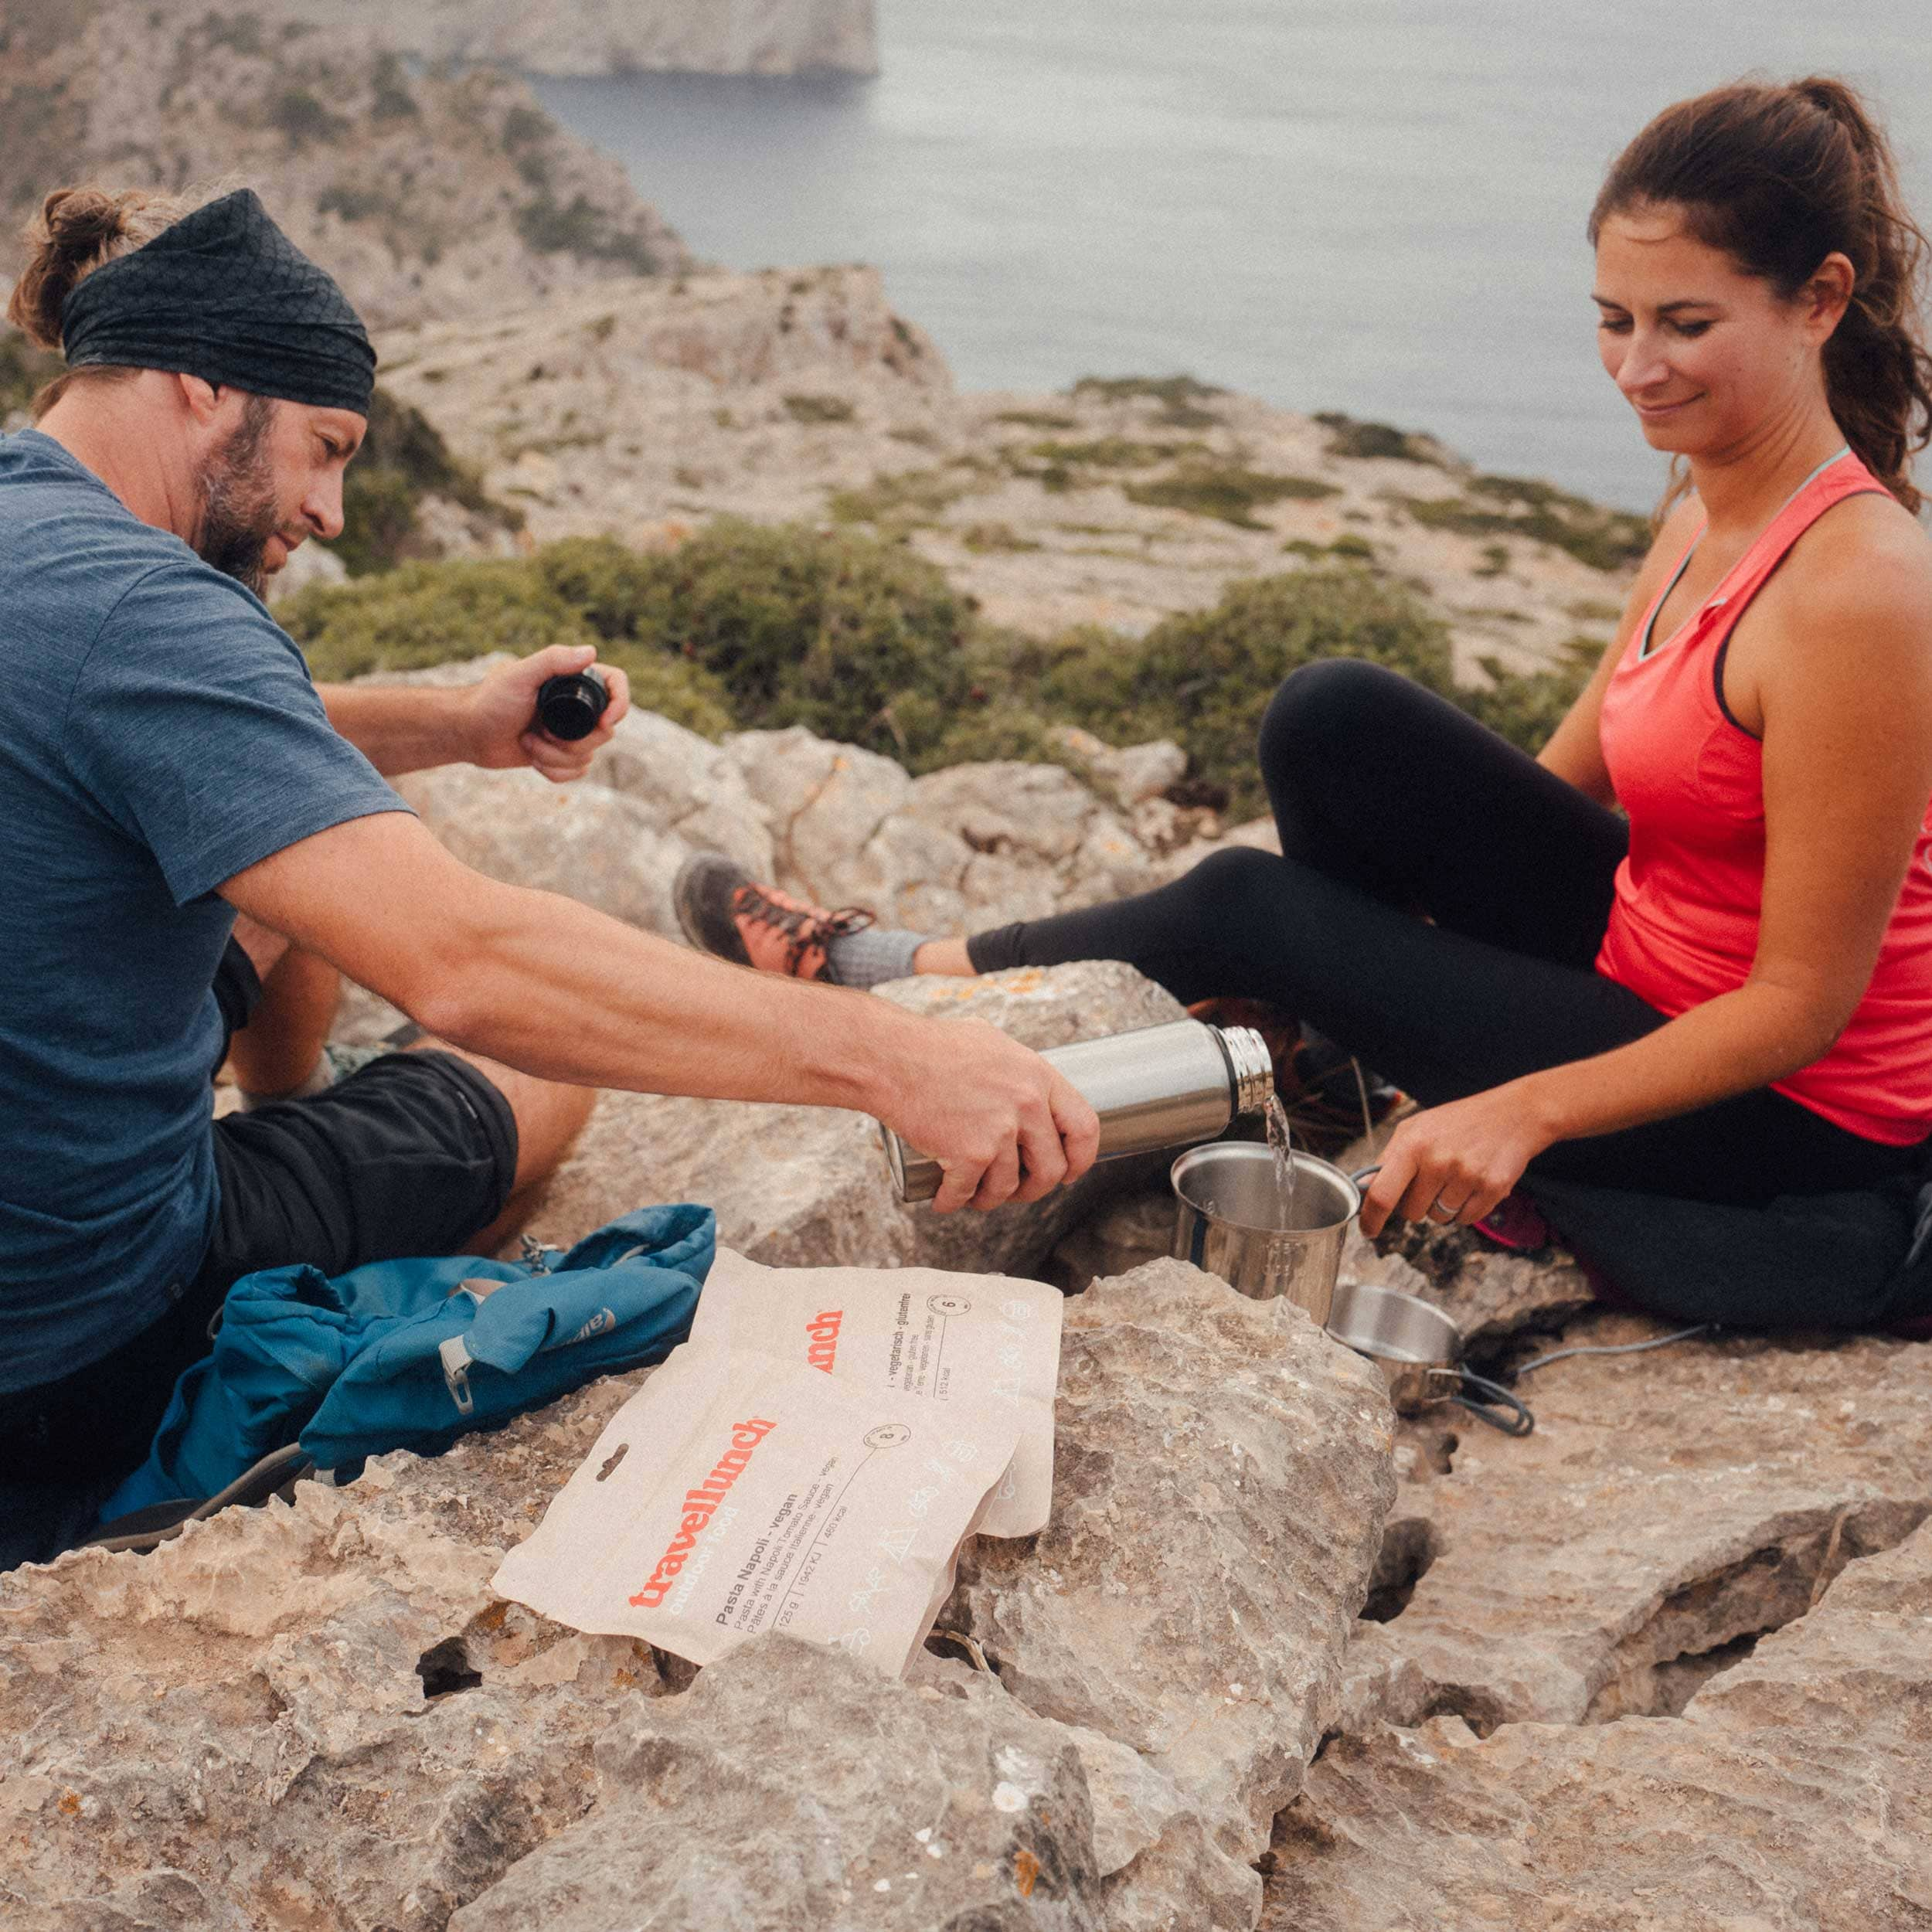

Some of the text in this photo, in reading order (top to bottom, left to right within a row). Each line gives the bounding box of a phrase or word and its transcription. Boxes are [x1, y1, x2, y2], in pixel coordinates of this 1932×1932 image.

[889, 1331, 903, 1376] vegetarisch
[895, 1293, 910, 1325] glutenfrei
[940, 1381, 949, 1394] 512
[628, 1419, 778, 1607] travellunch
[716, 1583, 744, 1626] Pasta
[737, 1539, 770, 1580] Napoli
[770, 1493, 798, 1532] vegan
[734, 1600, 754, 1631] Pasta
[752, 1577, 767, 1597] with
[760, 1546, 784, 1576] Napoli
[778, 1512, 804, 1544] Tomato
[798, 1483, 821, 1510] Sauce
[747, 1604, 768, 1634] Pâtes
[774, 1552, 795, 1582] sauce
[791, 1513, 816, 1550] Italienne
[779, 1609, 794, 1628] 125
[789, 1600, 800, 1611] g
[798, 1565, 816, 1587] 1942
[832, 1505, 848, 1522] kcal
[669, 1546, 713, 1615] outdoor
